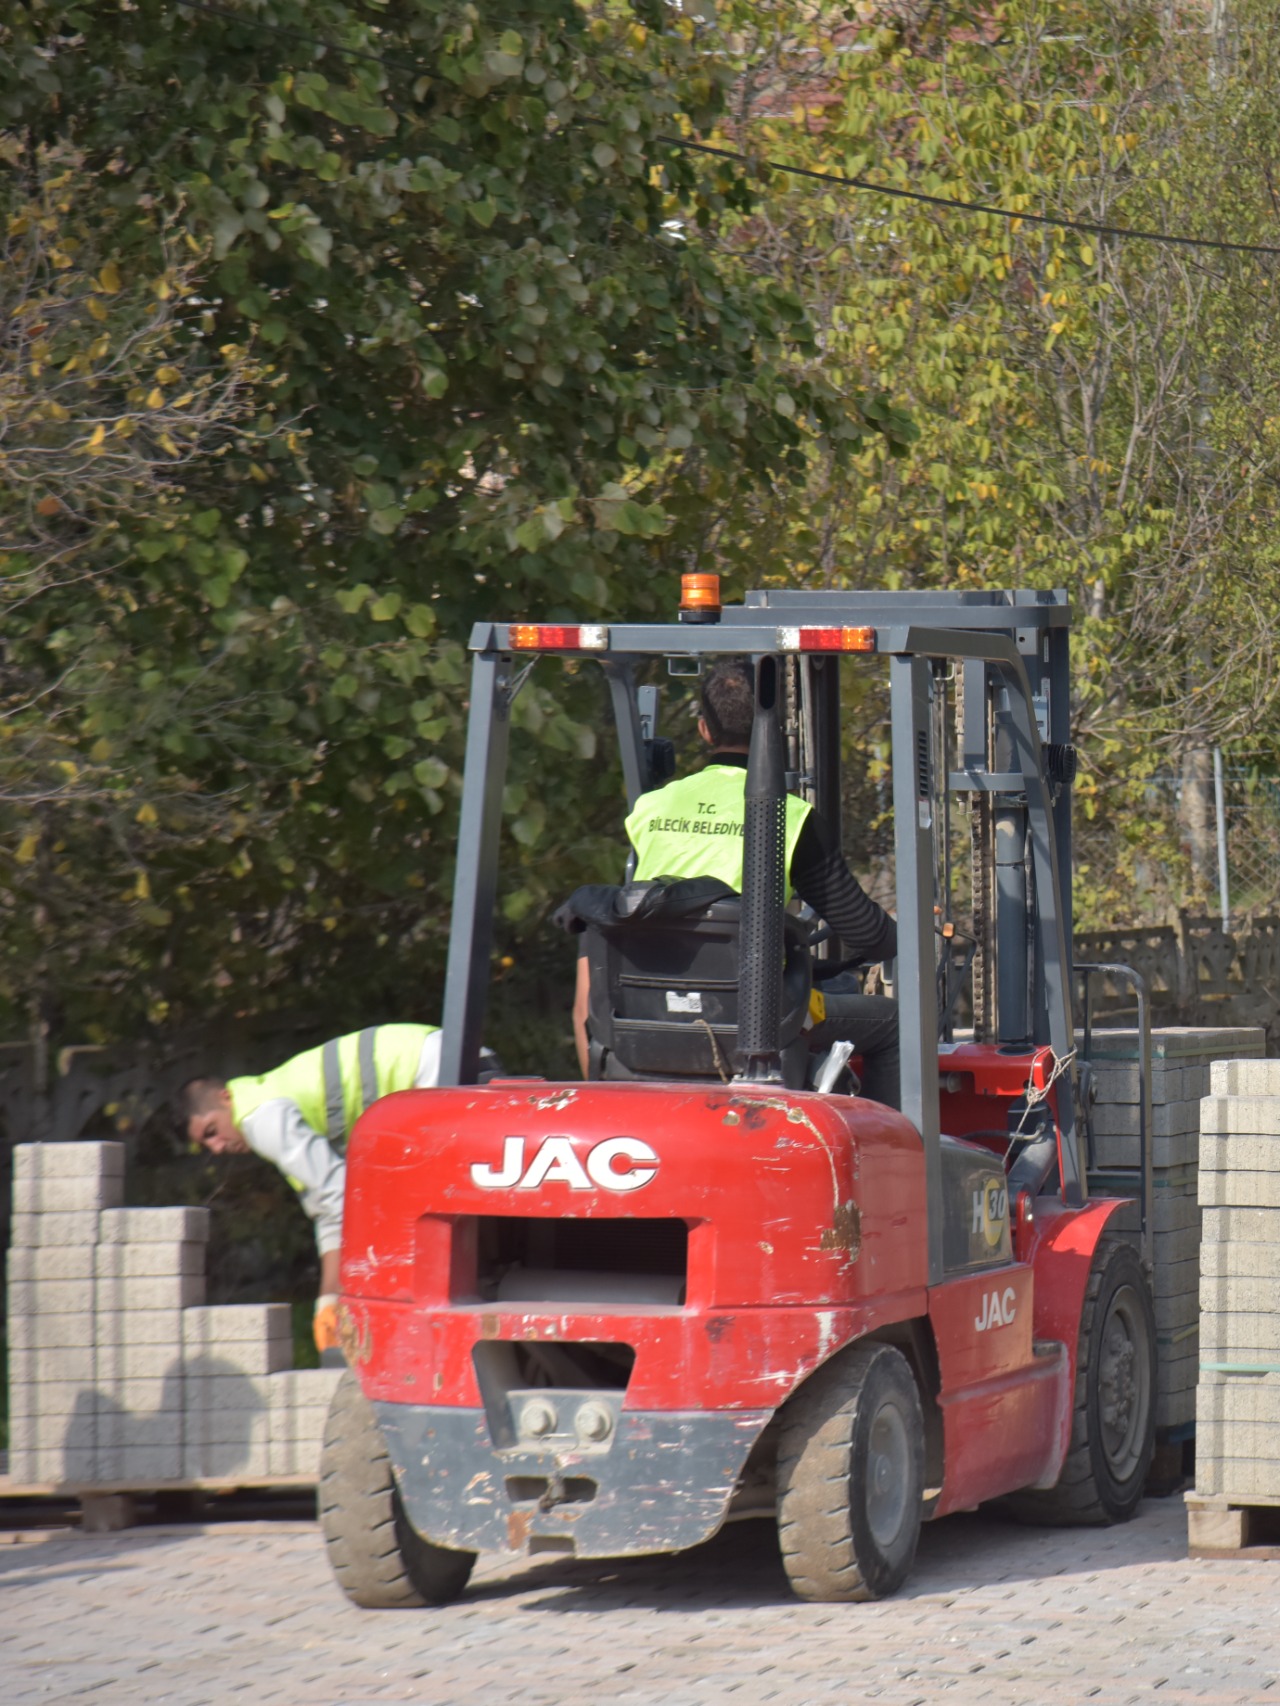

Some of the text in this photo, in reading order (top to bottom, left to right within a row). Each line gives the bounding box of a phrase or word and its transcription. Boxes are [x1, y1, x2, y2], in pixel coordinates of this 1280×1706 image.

[697, 802, 717, 814] T.C.
[470, 1136, 659, 1192] JAC
[975, 1287, 1016, 1332] JAC
